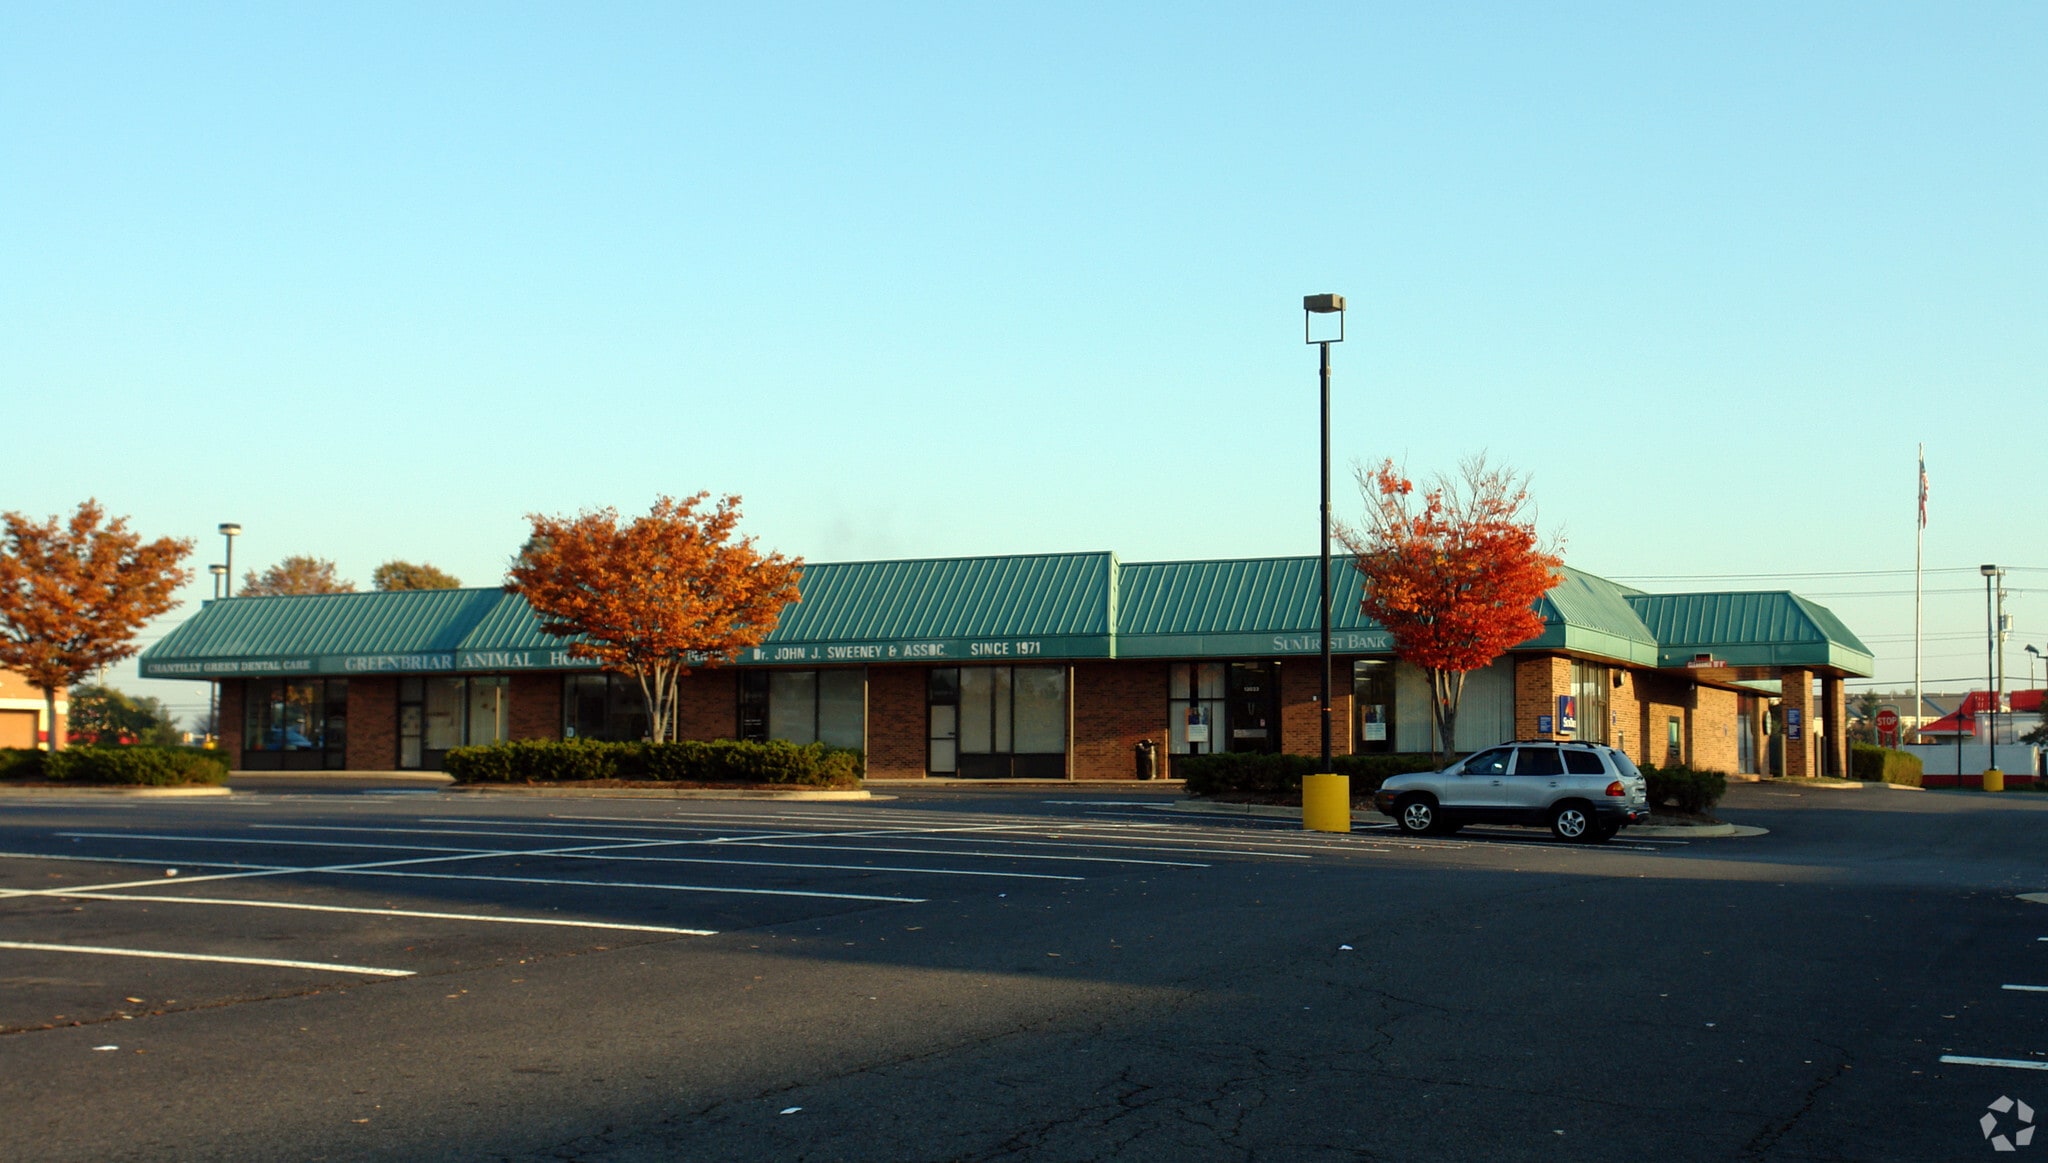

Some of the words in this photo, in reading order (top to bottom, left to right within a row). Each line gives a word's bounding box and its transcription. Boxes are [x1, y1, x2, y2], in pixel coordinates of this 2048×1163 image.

[774, 647, 806, 660] JOHN
[811, 646, 822, 659] J.
[827, 645, 883, 659] SWEENEY
[888, 645, 898, 657] &
[970, 643, 1009, 656] SINCE
[1015, 641, 1041, 655] 1971
[1273, 634, 1345, 651] SUNTRST
[1348, 634, 1387, 649] BANK
[147, 662, 202, 673] CHANTILLY
[203, 661, 238, 672] GREEN
[241, 661, 281, 671] DENTAL
[283, 660, 310, 670] CARE
[344, 654, 453, 671] GREENBRIAR
[460, 650, 534, 668] ANIMAL
[1877, 716, 1897, 726] STOP
